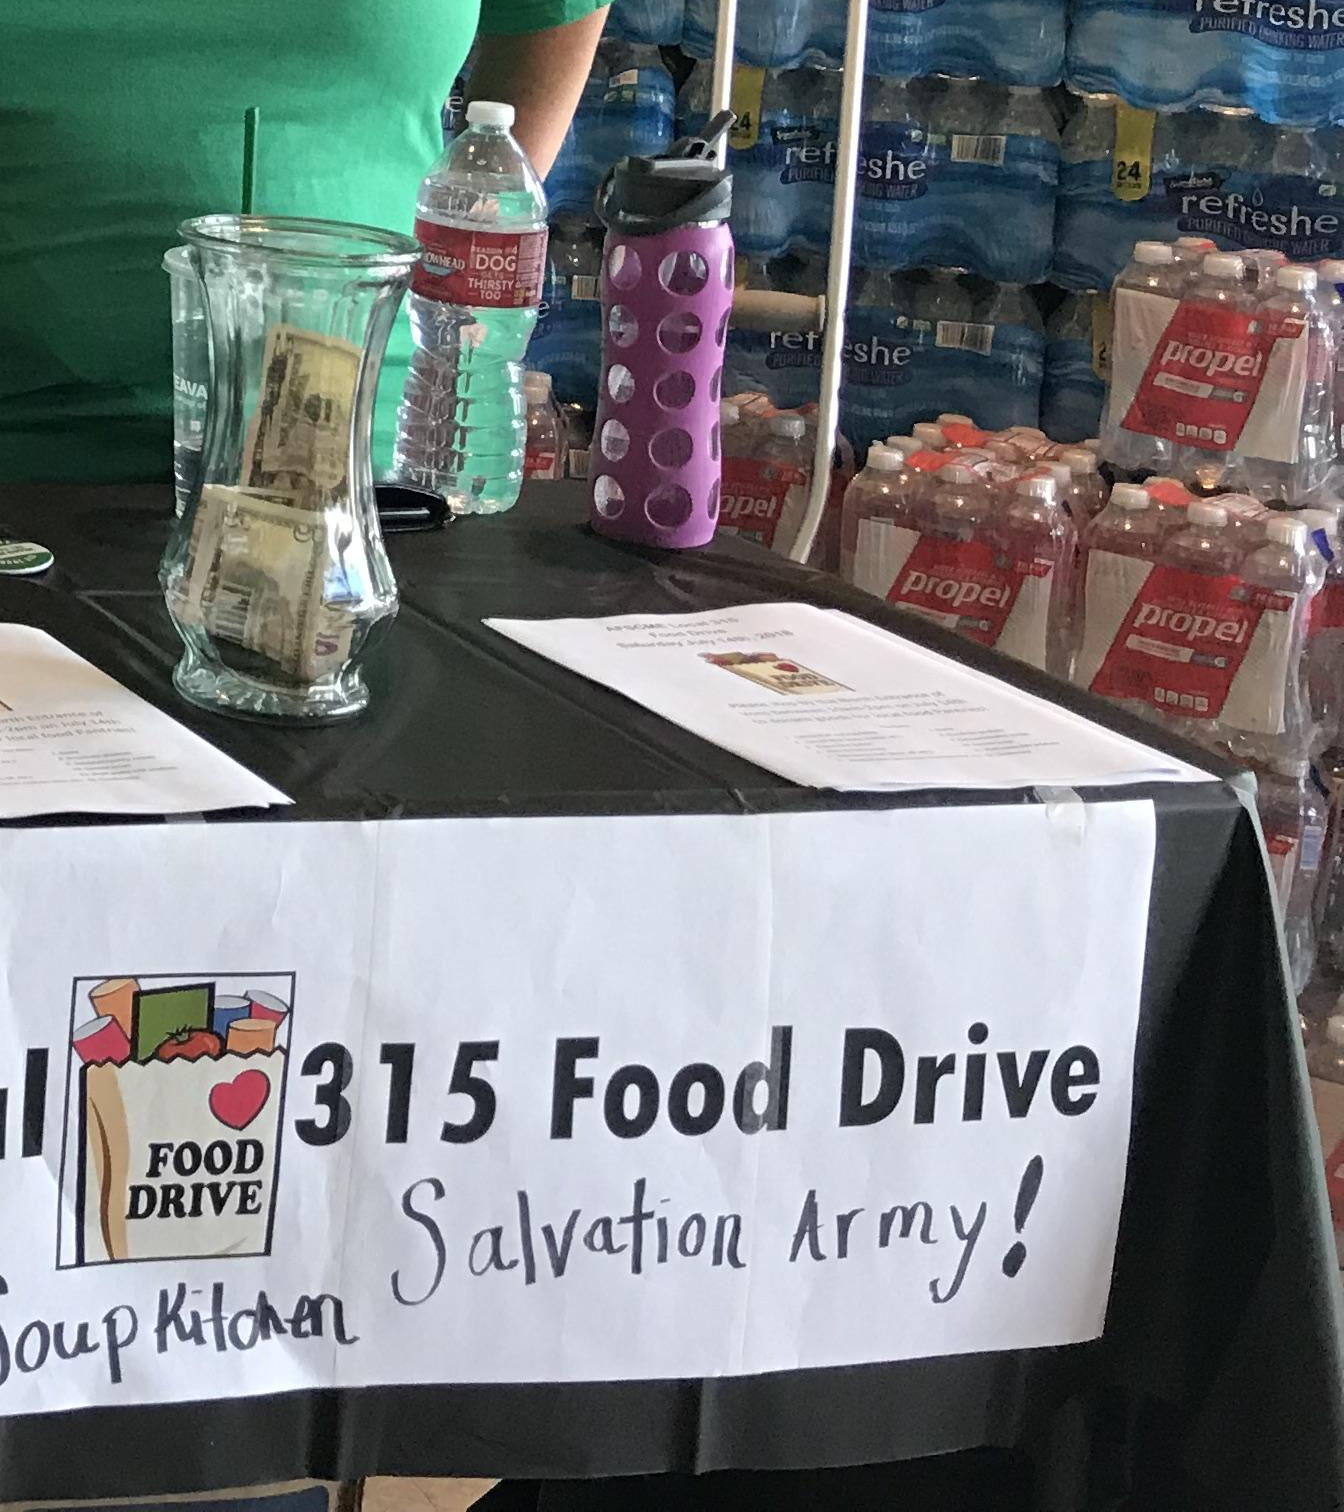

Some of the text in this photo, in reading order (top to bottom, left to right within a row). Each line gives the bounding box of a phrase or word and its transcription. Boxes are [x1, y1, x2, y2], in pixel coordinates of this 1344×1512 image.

[1116, 160, 1143, 182] 24
[1181, 191, 1339, 236] refreshe
[475, 254, 517, 272] DOG
[467, 278, 514, 291] THIRSTY
[479, 289, 503, 300] TOO
[1161, 340, 1263, 377] propel
[900, 568, 1011, 609] propel
[1132, 600, 1249, 647] propel
[295, 1040, 502, 1148] 315
[550, 1025, 792, 1140] Food
[839, 1022, 1101, 1128] Drive
[145, 1137, 265, 1181] FOOD
[125, 1179, 263, 1222] DRIVE
[388, 1154, 1046, 1308] Salvation Army!
